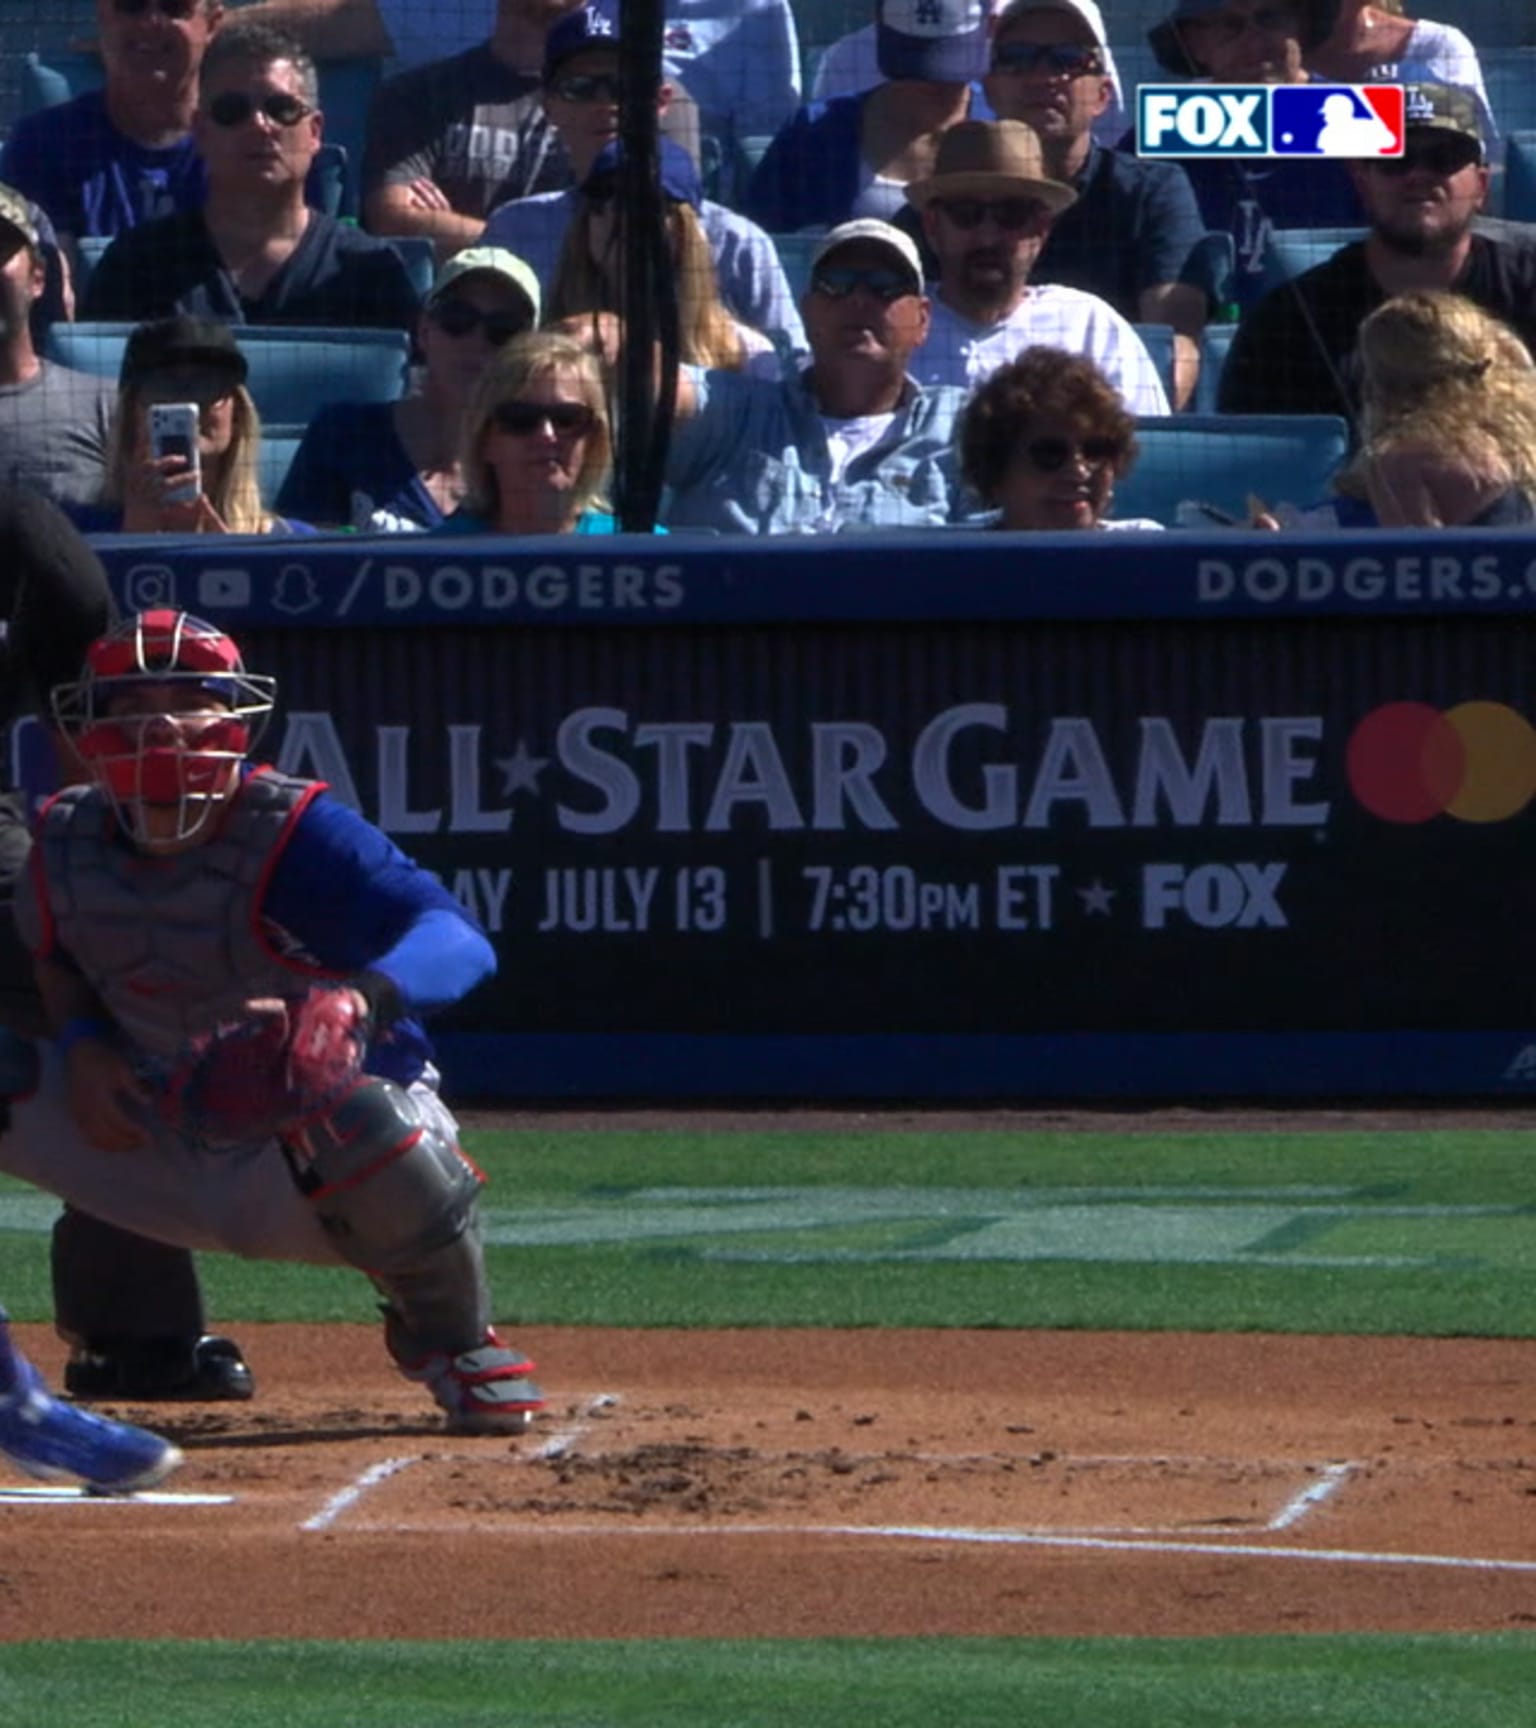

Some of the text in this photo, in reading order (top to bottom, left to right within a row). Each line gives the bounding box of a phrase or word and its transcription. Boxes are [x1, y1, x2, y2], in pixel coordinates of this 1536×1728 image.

[1197, 556, 1536, 602] DODGERS.
[277, 702, 1331, 833] ALL STAR GAME
[537, 867, 659, 933] JULY
[675, 866, 727, 931] 13
[803, 865, 980, 931] 7:30PM
[997, 864, 1060, 930] ET
[1142, 862, 1289, 929] FOX
